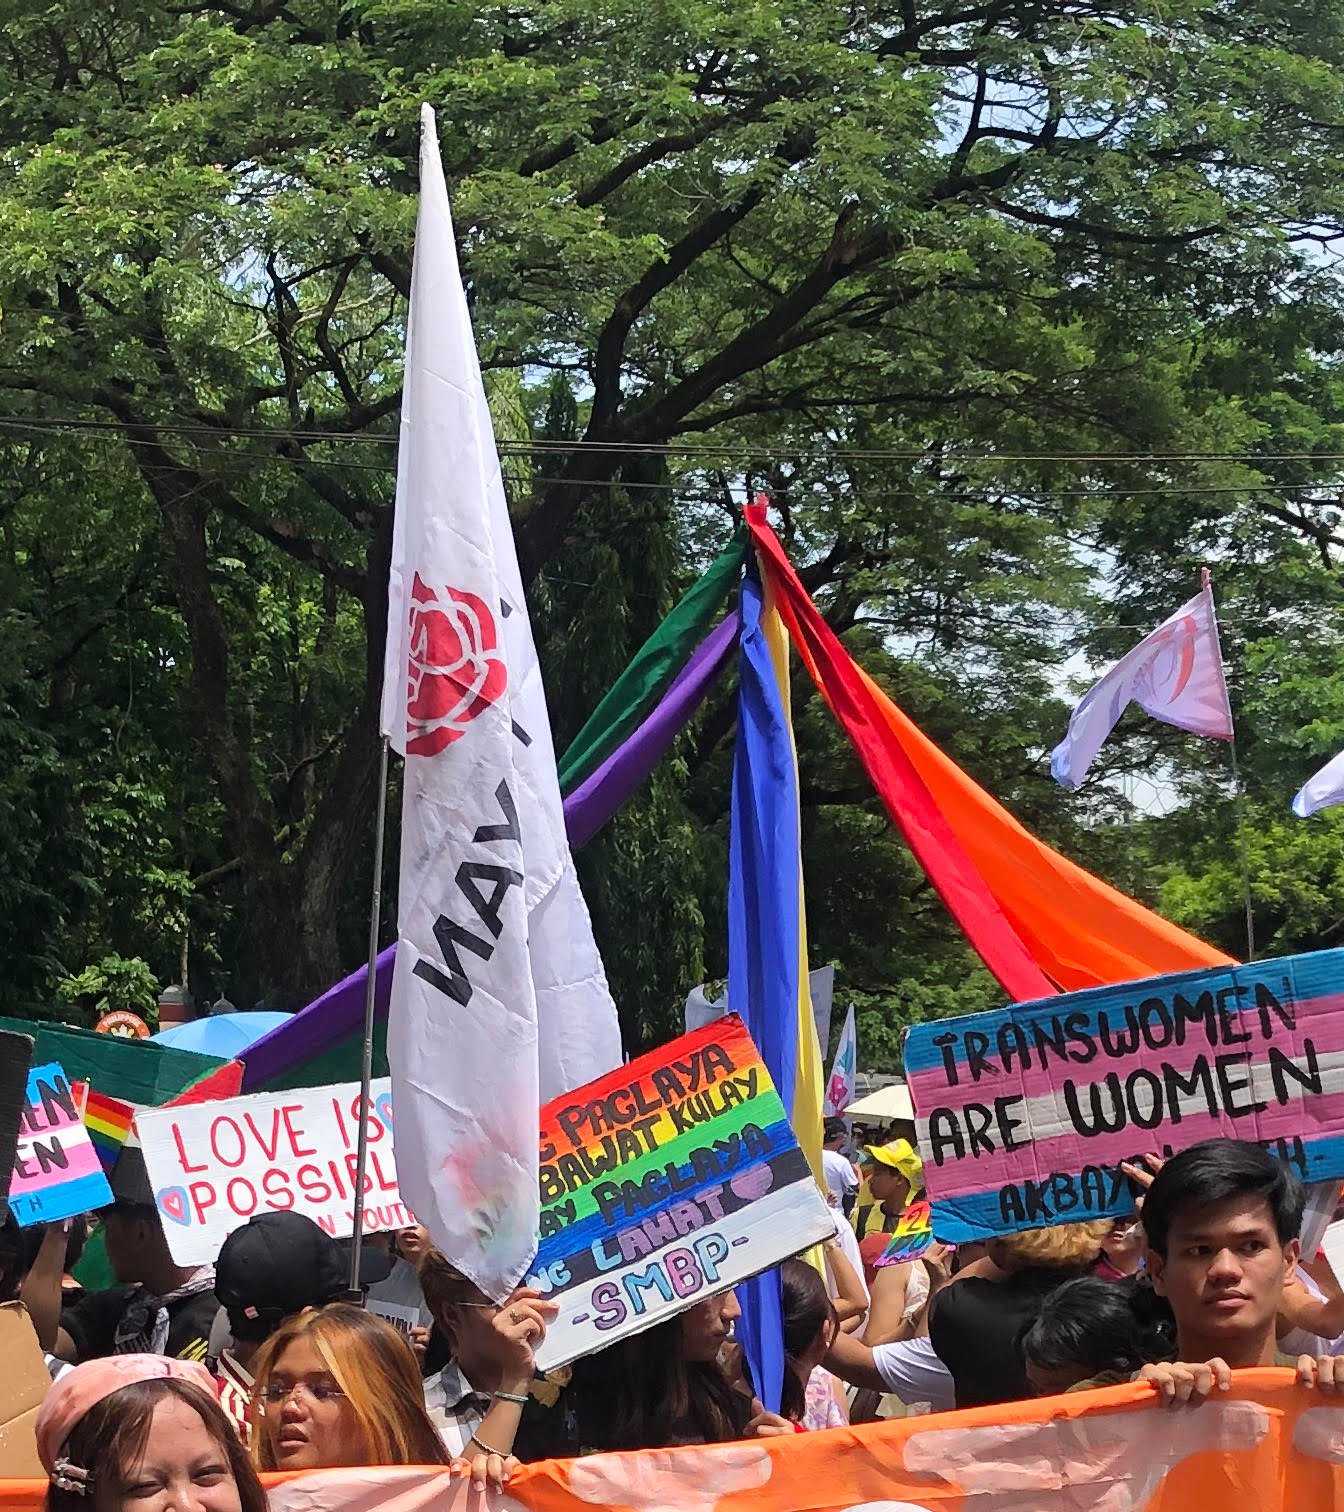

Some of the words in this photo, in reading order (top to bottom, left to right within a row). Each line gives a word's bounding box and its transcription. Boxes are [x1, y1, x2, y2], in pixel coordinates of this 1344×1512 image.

[932, 976, 1298, 1087] TRANSWOMEN
[171, 1104, 317, 1173] LOVE
[332, 1094, 385, 1149] IS
[539, 1114, 662, 1206] BAWAT
[667, 1067, 758, 1136] KULAY
[556, 1043, 737, 1147] PAGLAYA
[929, 1095, 1032, 1167] ARE
[1064, 1038, 1323, 1138] WOMEN
[189, 1151, 398, 1225] POSSIBL
[591, 1122, 773, 1226] PAGLAYA
